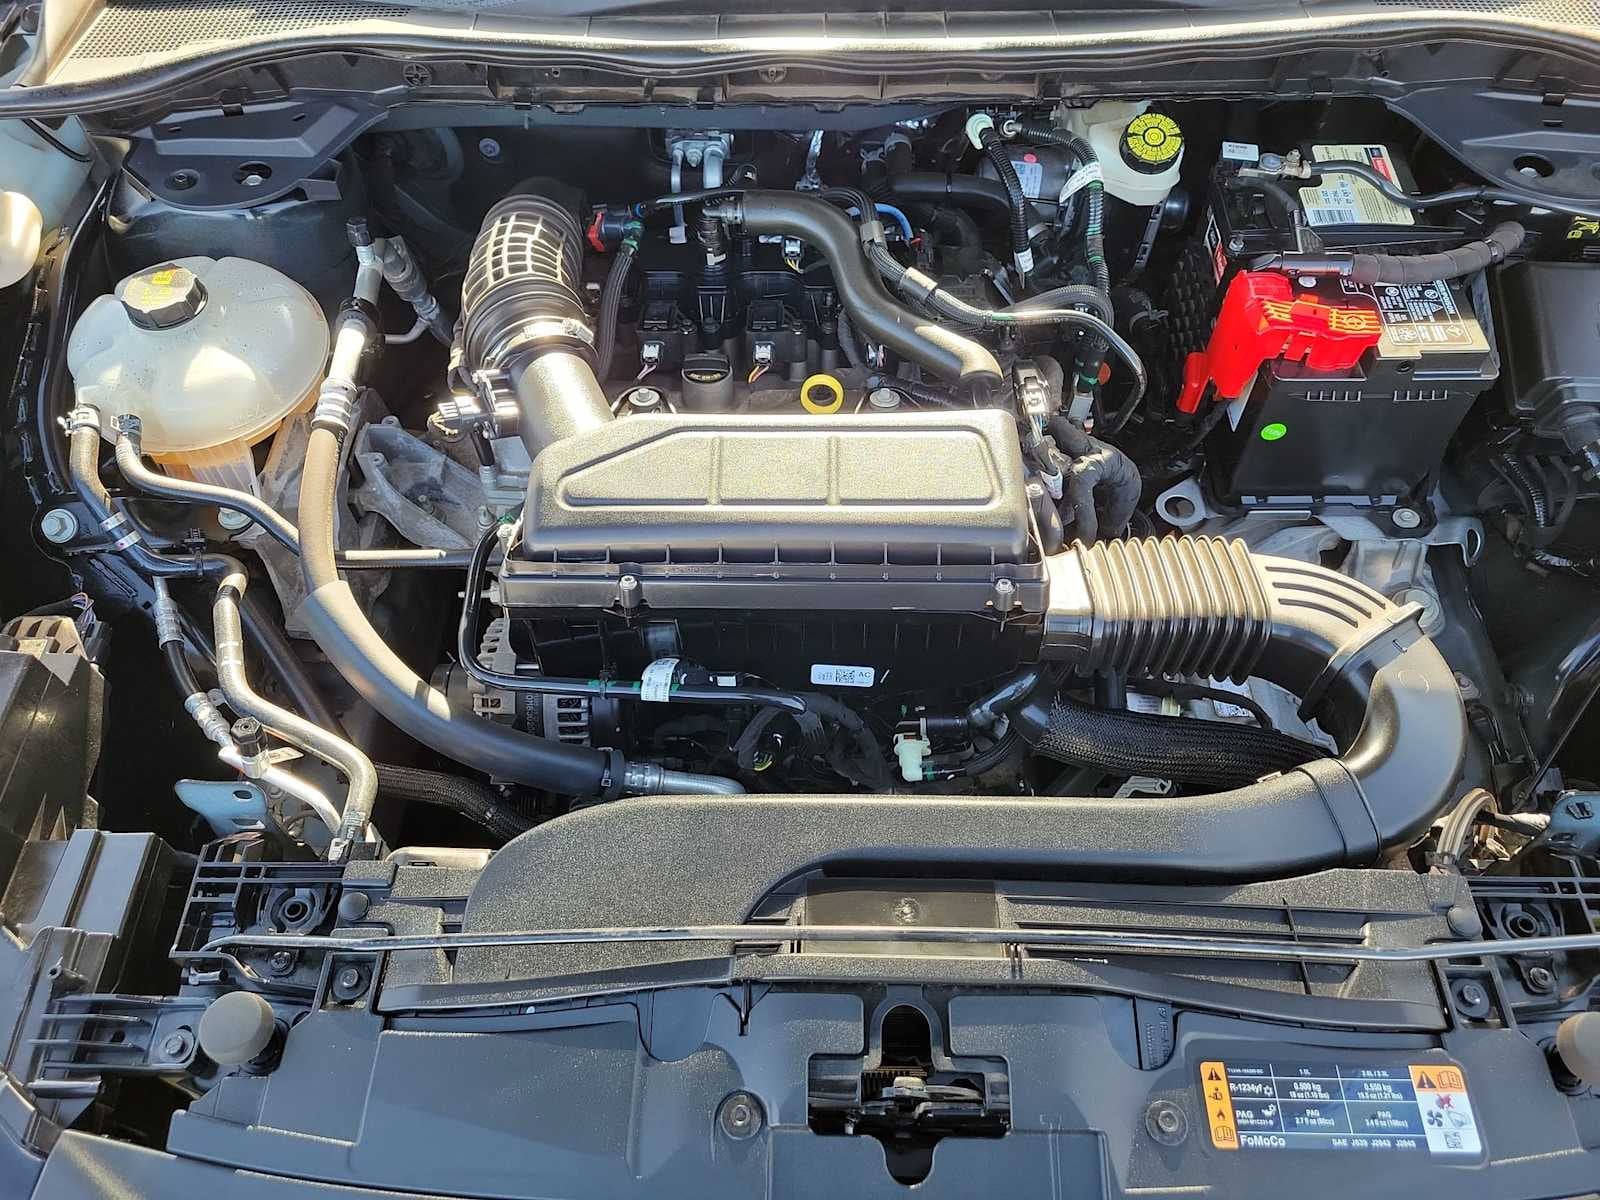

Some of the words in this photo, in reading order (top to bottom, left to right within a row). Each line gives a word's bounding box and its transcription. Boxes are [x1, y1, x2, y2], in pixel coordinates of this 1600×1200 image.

[858, 671, 872, 679] AC
[1229, 1082, 1263, 1094] R-1234yf
[1312, 1082, 1321, 1093] kg
[1236, 1110, 1253, 1119] PAG
[1306, 1109, 1320, 1117] PAG
[1377, 1110, 1392, 1119] PAG
[1240, 1135, 1286, 1148] FoMoCo
[1332, 1138, 1347, 1147] SAE
